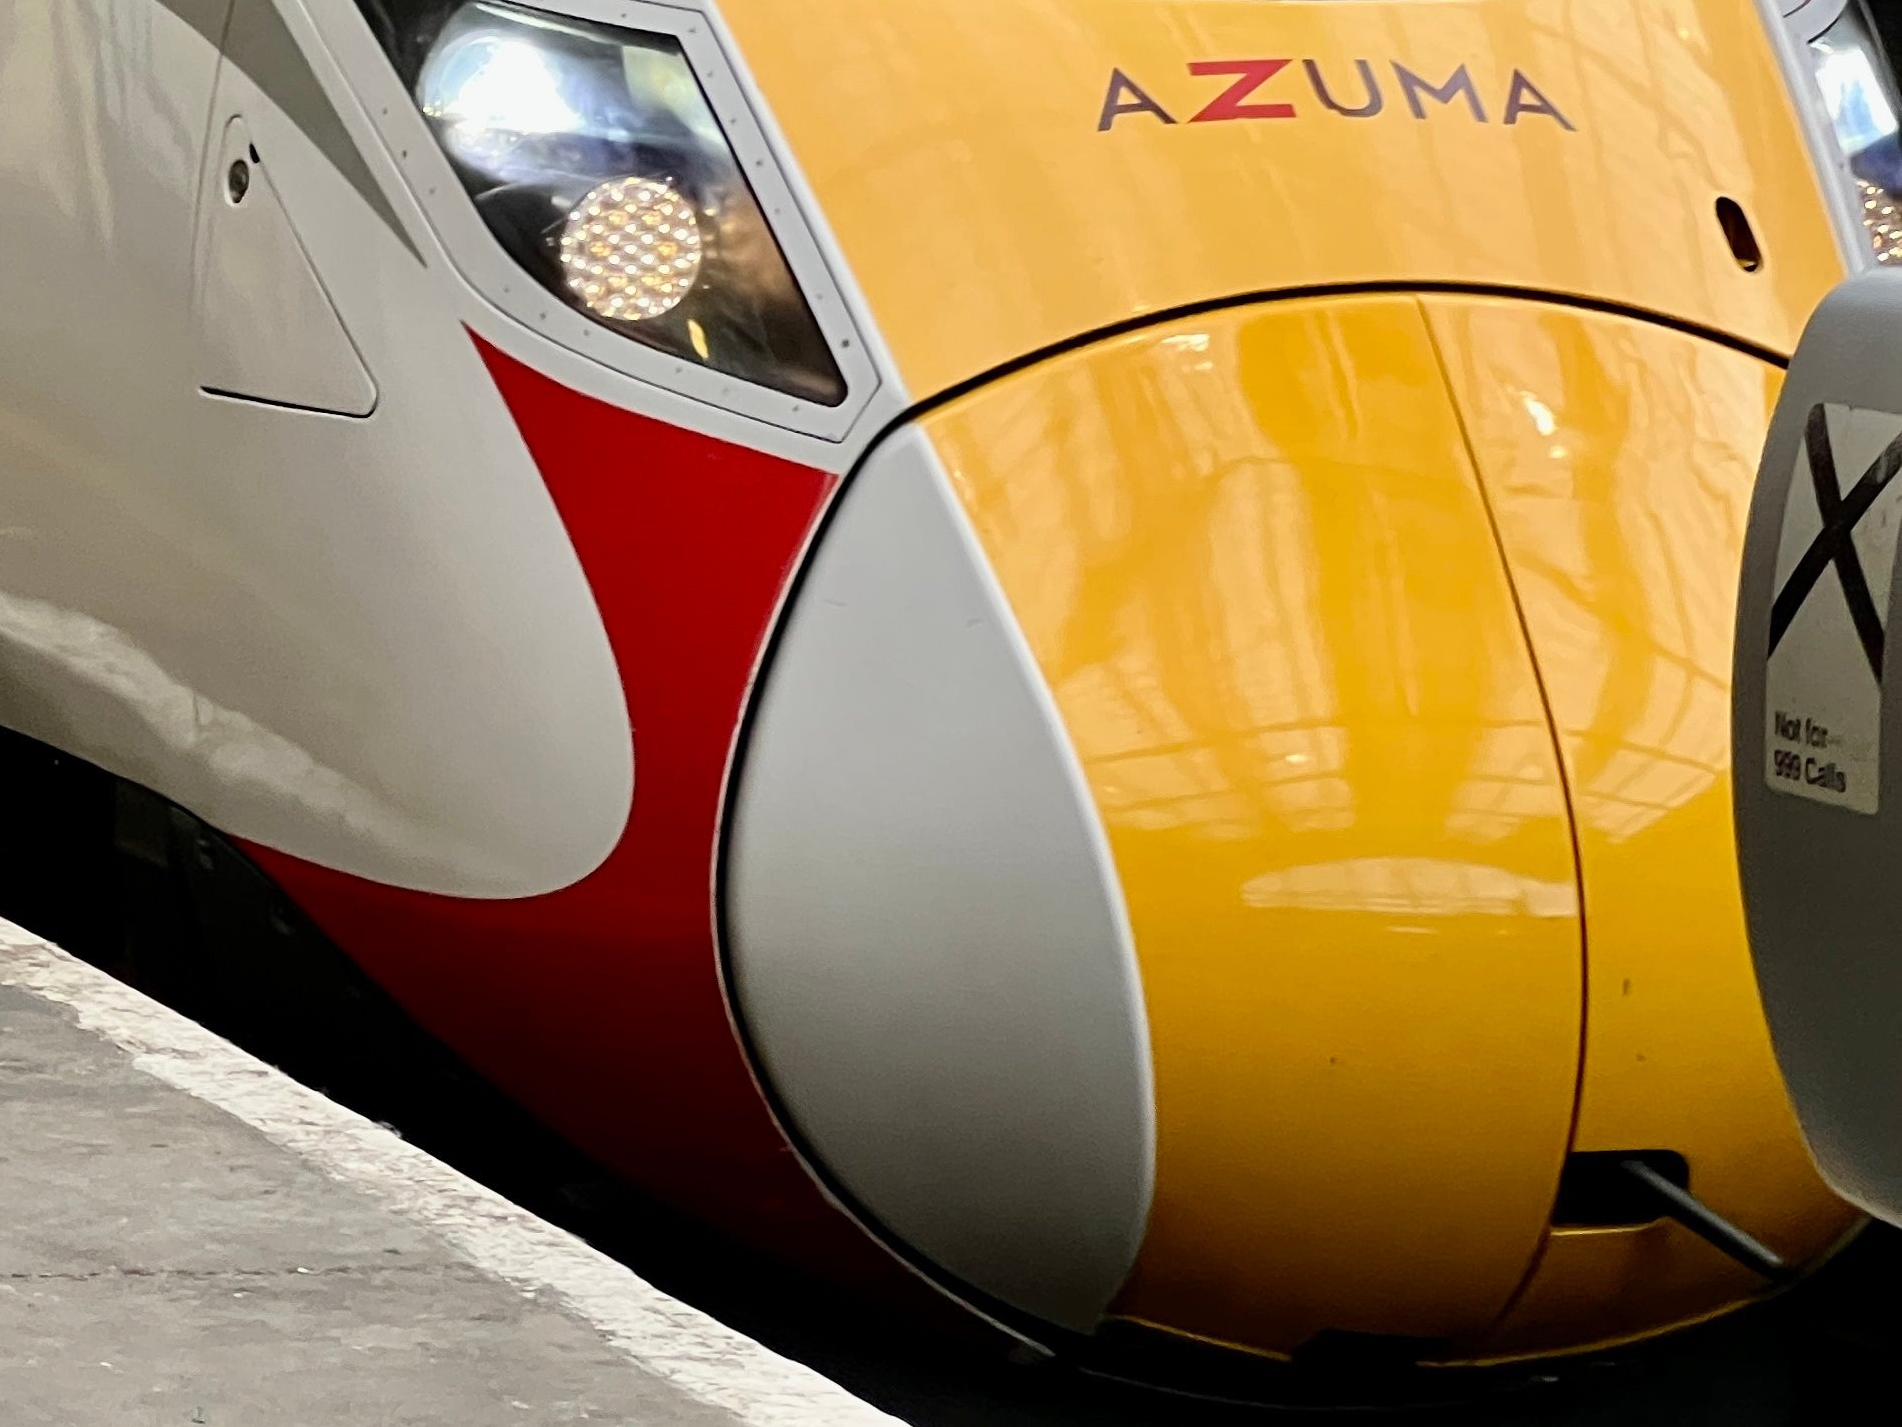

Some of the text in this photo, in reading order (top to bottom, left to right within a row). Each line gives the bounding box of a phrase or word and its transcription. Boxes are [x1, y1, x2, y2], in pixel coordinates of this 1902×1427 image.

[1097, 58, 1578, 132] AZUMA
[1774, 710, 1801, 744] Not
[1805, 757, 1847, 793] Calls
